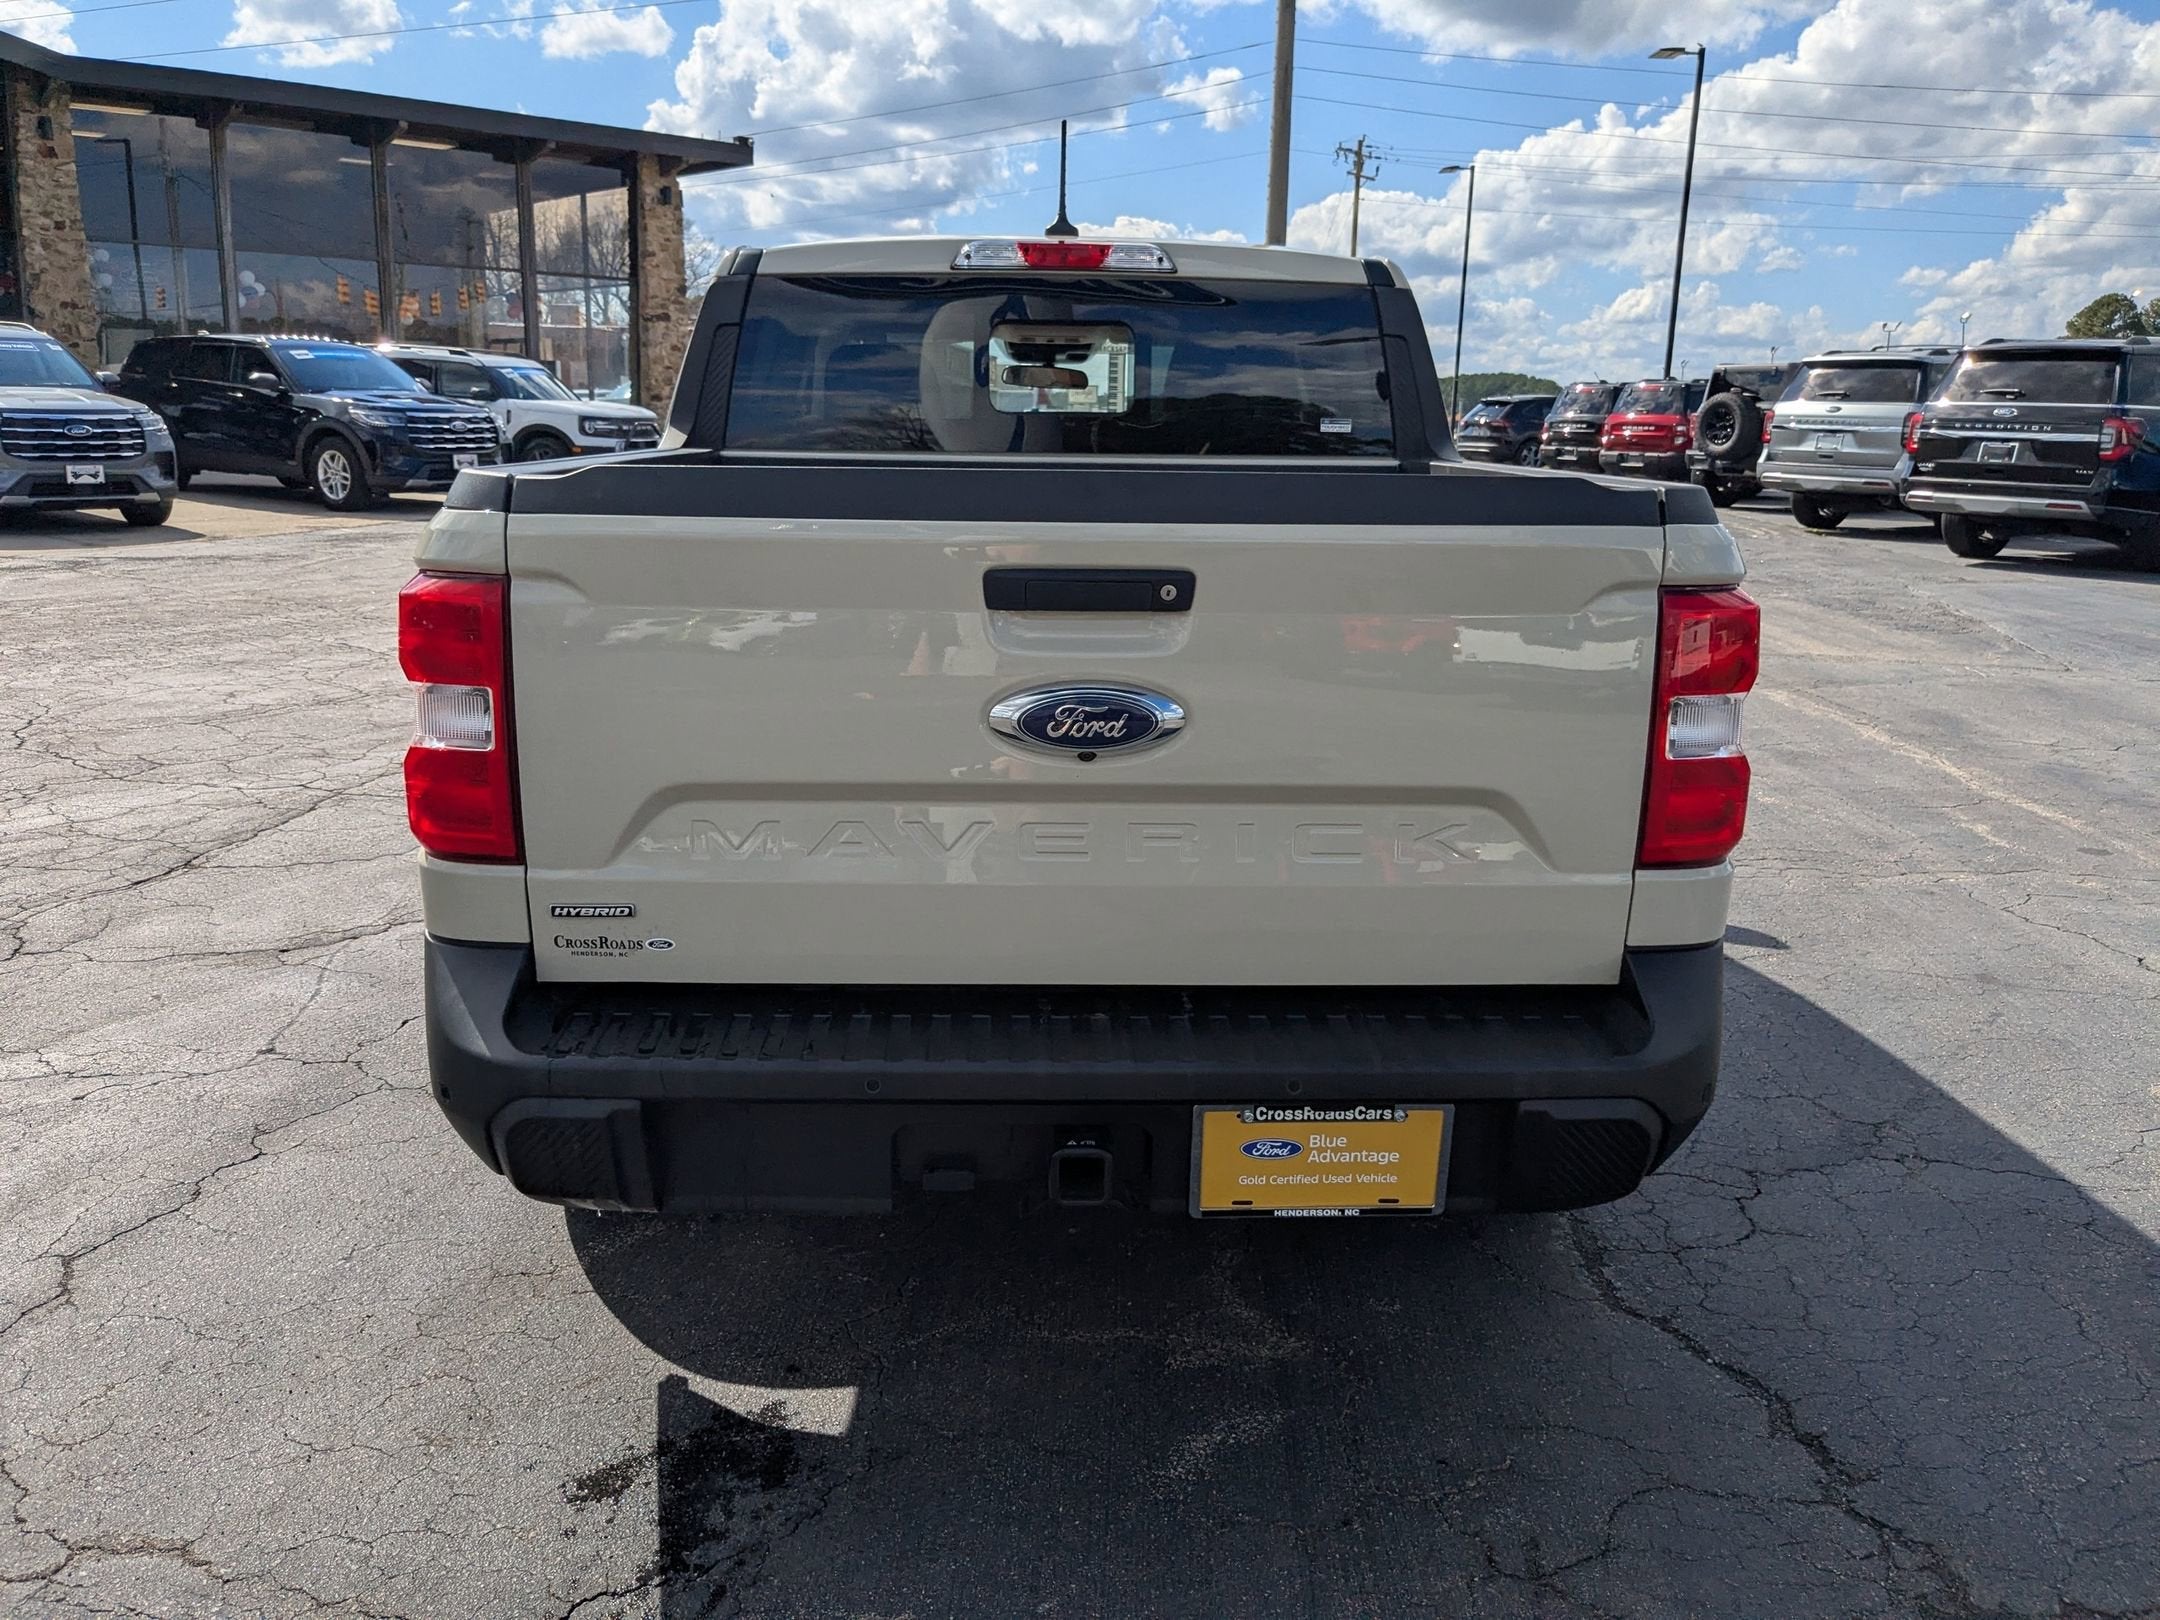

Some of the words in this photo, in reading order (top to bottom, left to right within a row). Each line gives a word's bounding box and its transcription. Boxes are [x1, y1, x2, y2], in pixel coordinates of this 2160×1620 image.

[1046, 704, 1129, 738] Ford
[690, 819, 1478, 864] MAVERICK
[553, 907, 630, 917] HYBRID
[1255, 1105, 1393, 1121] CrossRoadsCars
[1251, 1141, 1291, 1157] Ford
[1309, 1134, 1347, 1148] Blue
[1307, 1149, 1400, 1165] Advantage
[1238, 1175, 1266, 1185] Gold
[1269, 1174, 1319, 1185] Certified
[1322, 1174, 1352, 1184] Used
[1356, 1173, 1398, 1184] Vehicle
[1344, 1209, 1360, 1217] NC
